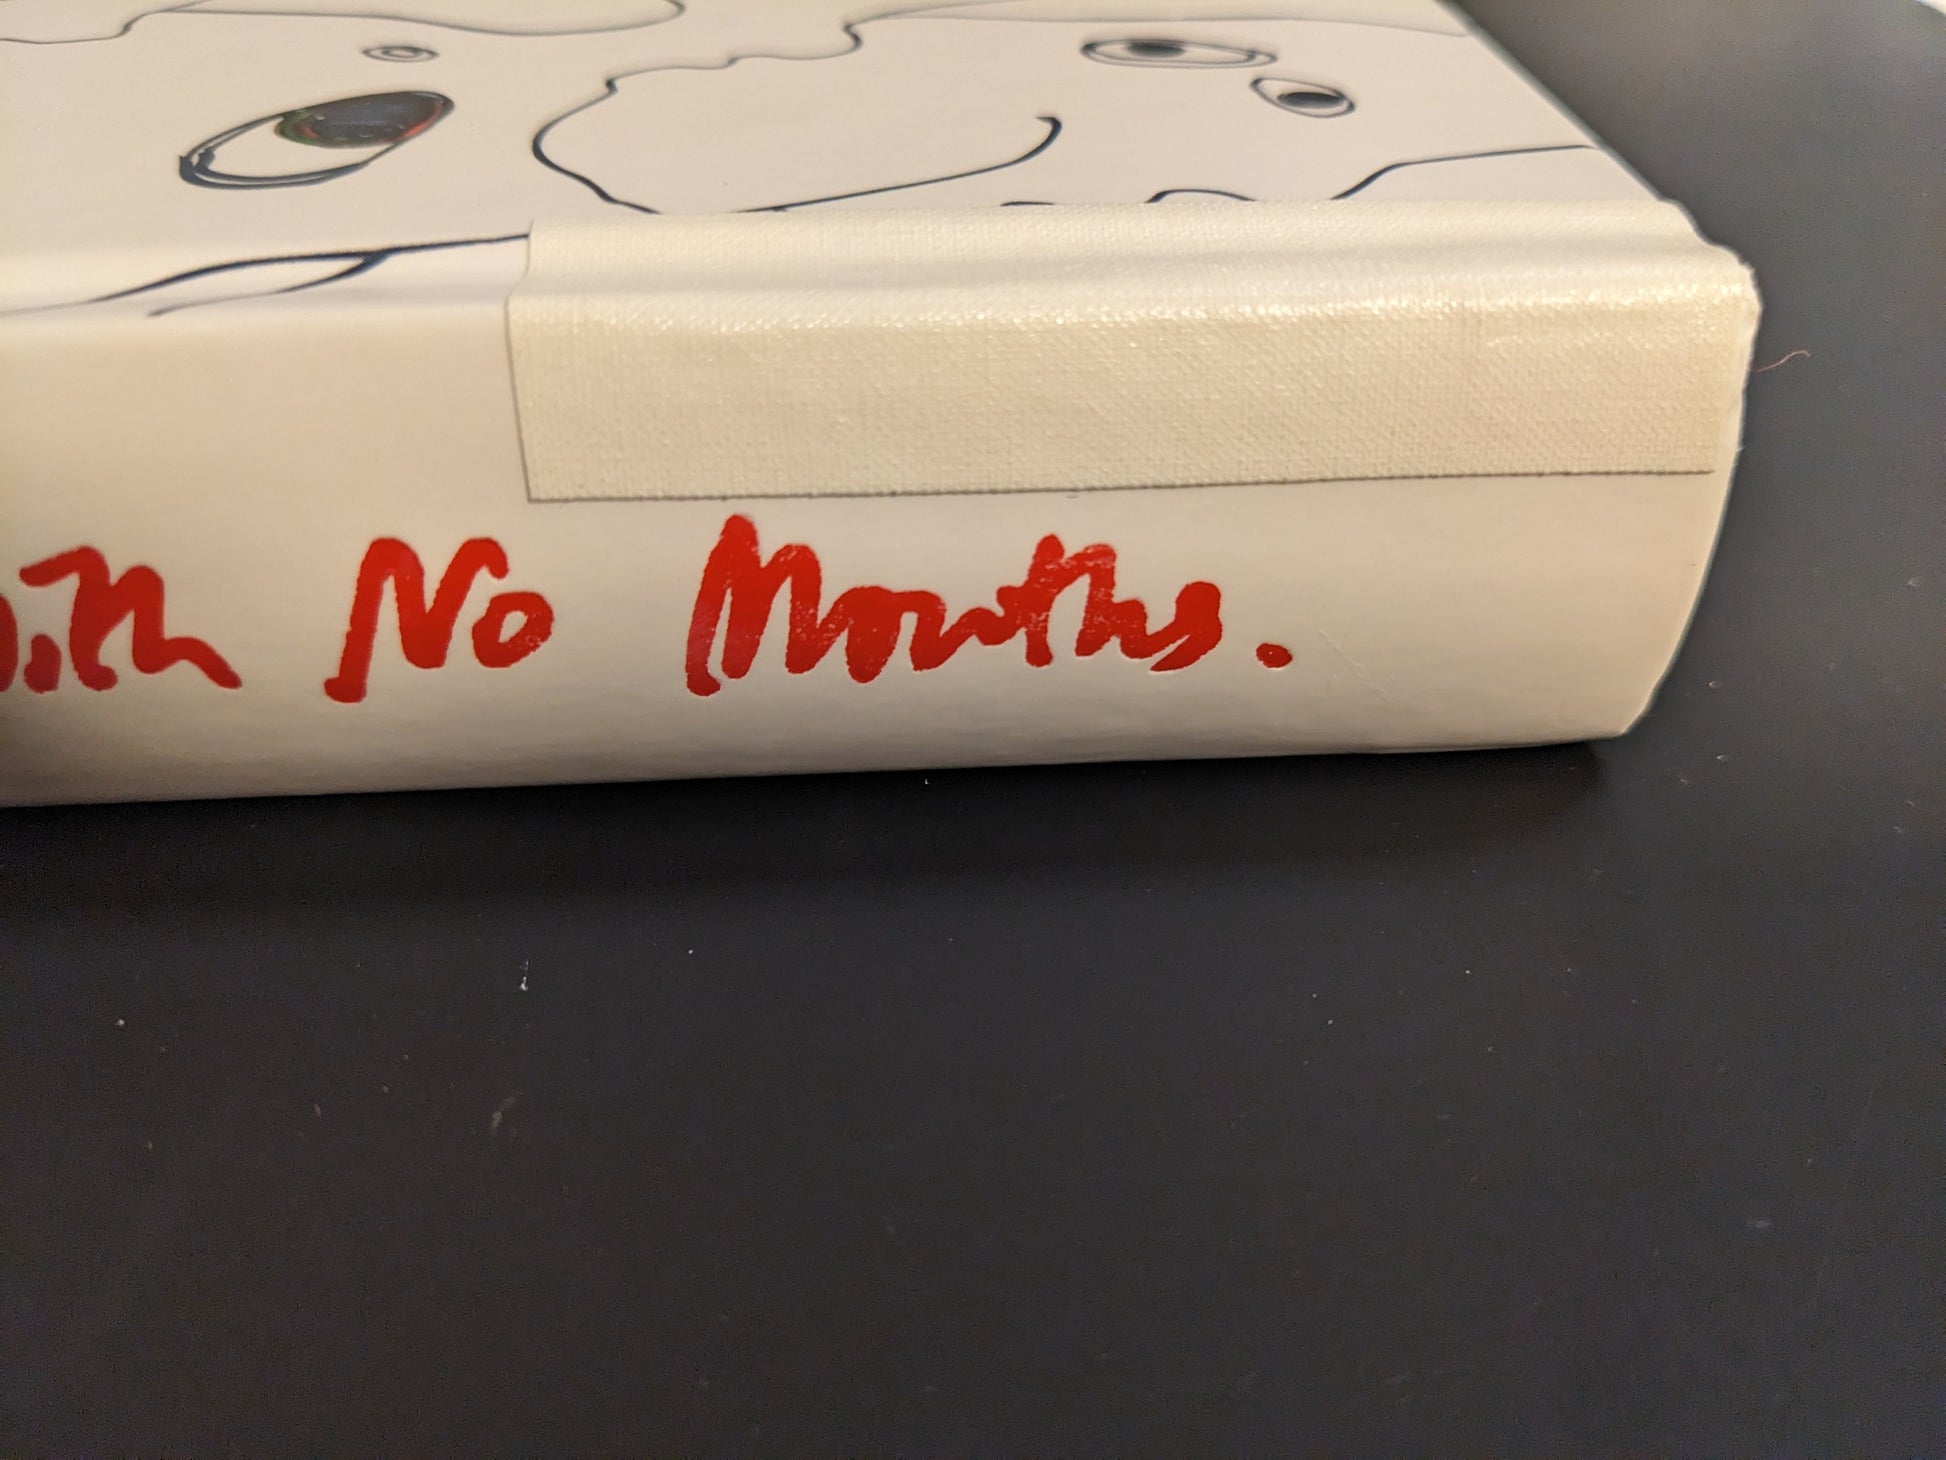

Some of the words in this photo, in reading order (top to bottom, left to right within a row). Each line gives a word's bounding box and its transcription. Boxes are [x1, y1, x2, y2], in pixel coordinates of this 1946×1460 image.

[0, 545, 242, 694] ith
[322, 536, 555, 704] No
[684, 513, 1293, 697] Months.
